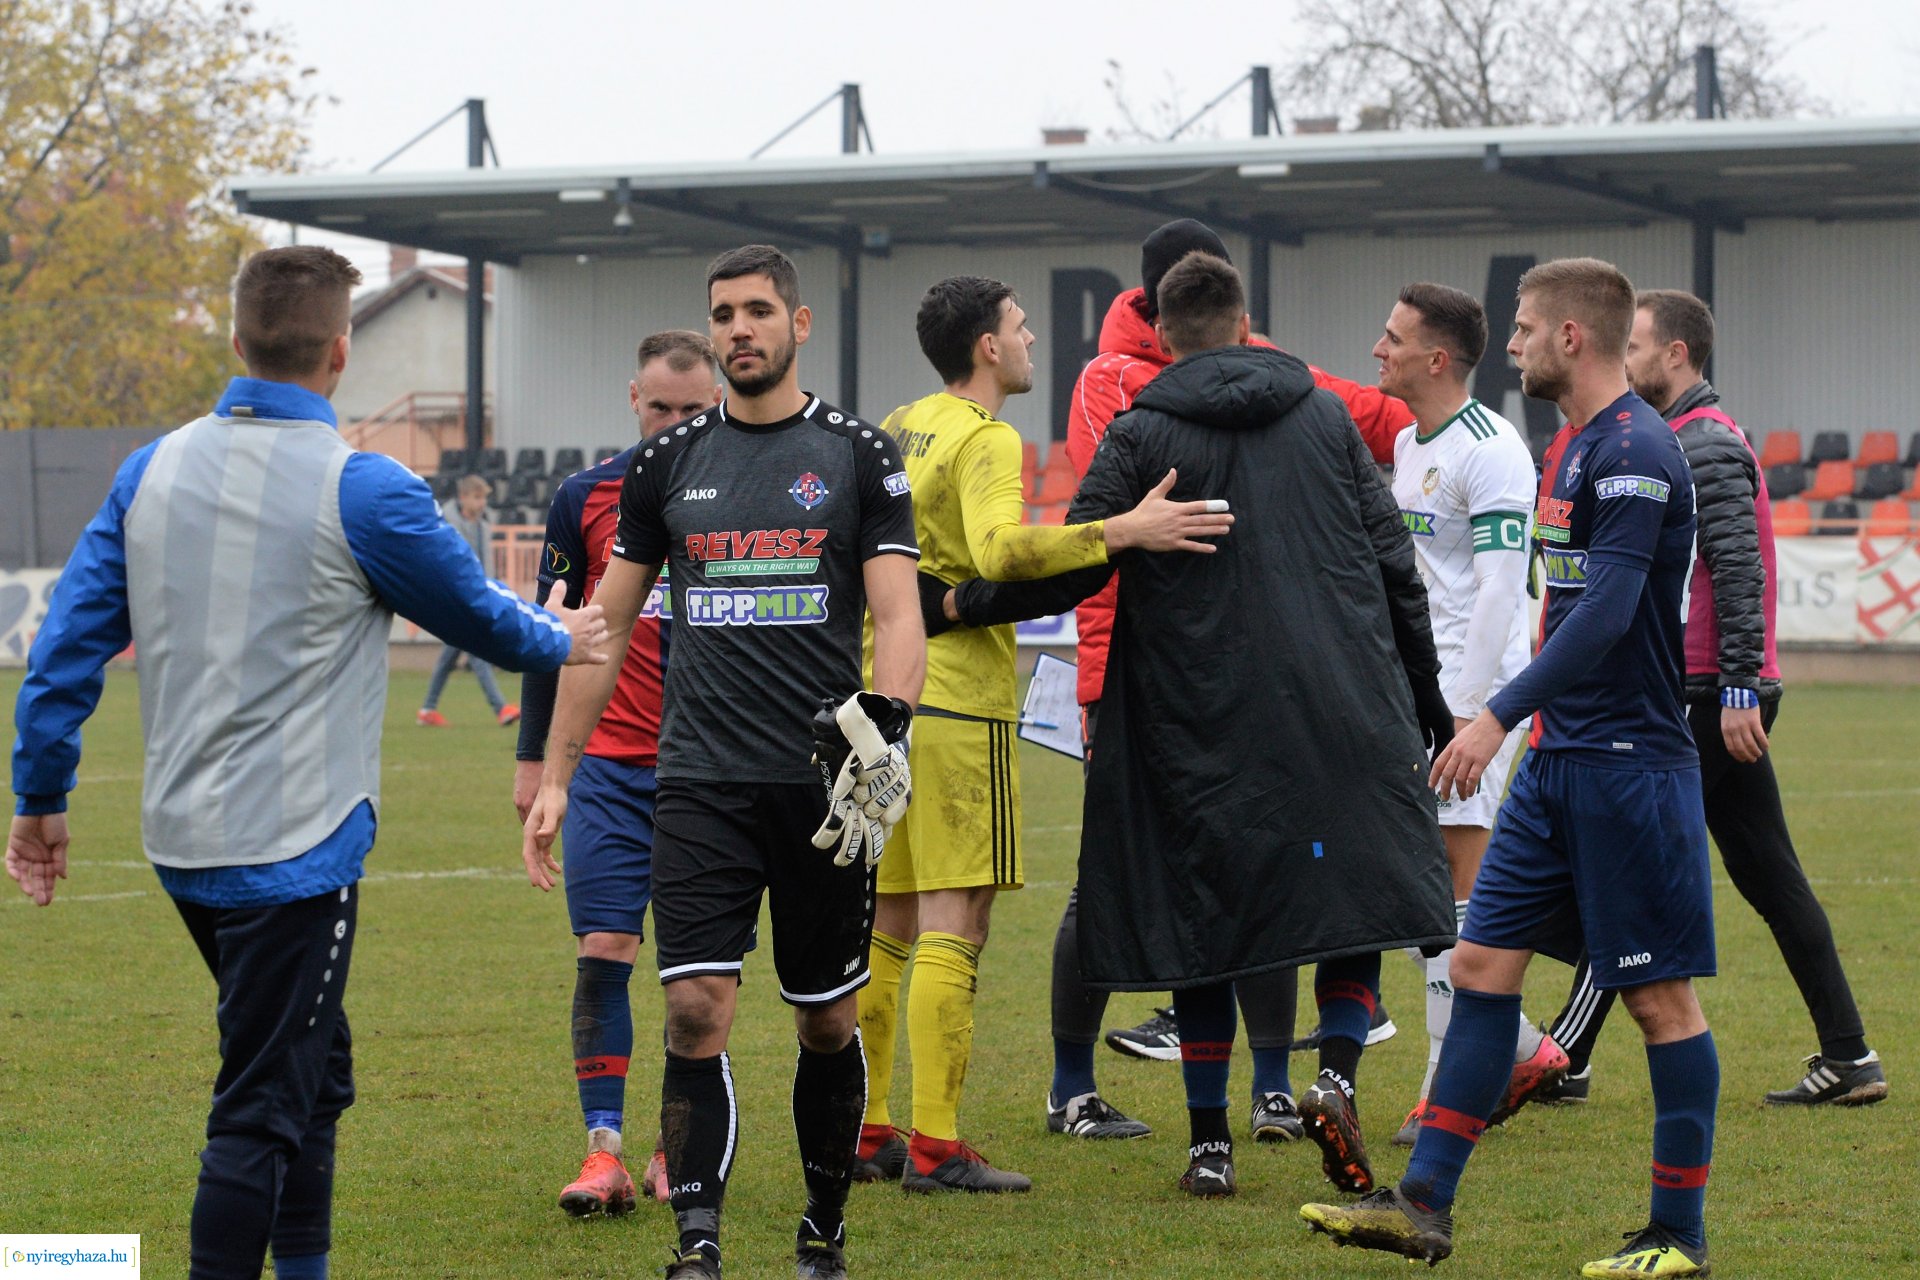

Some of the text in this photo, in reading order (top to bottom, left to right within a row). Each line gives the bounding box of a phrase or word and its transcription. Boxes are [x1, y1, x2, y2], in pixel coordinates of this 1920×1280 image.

[684, 488, 717, 500] JAKO
[1501, 519, 1523, 549] C
[686, 529, 828, 560] REVESZ
[708, 561, 816, 573] ALWAYS ON THE RIGHT WAY
[1618, 952, 1652, 968] JAKO
